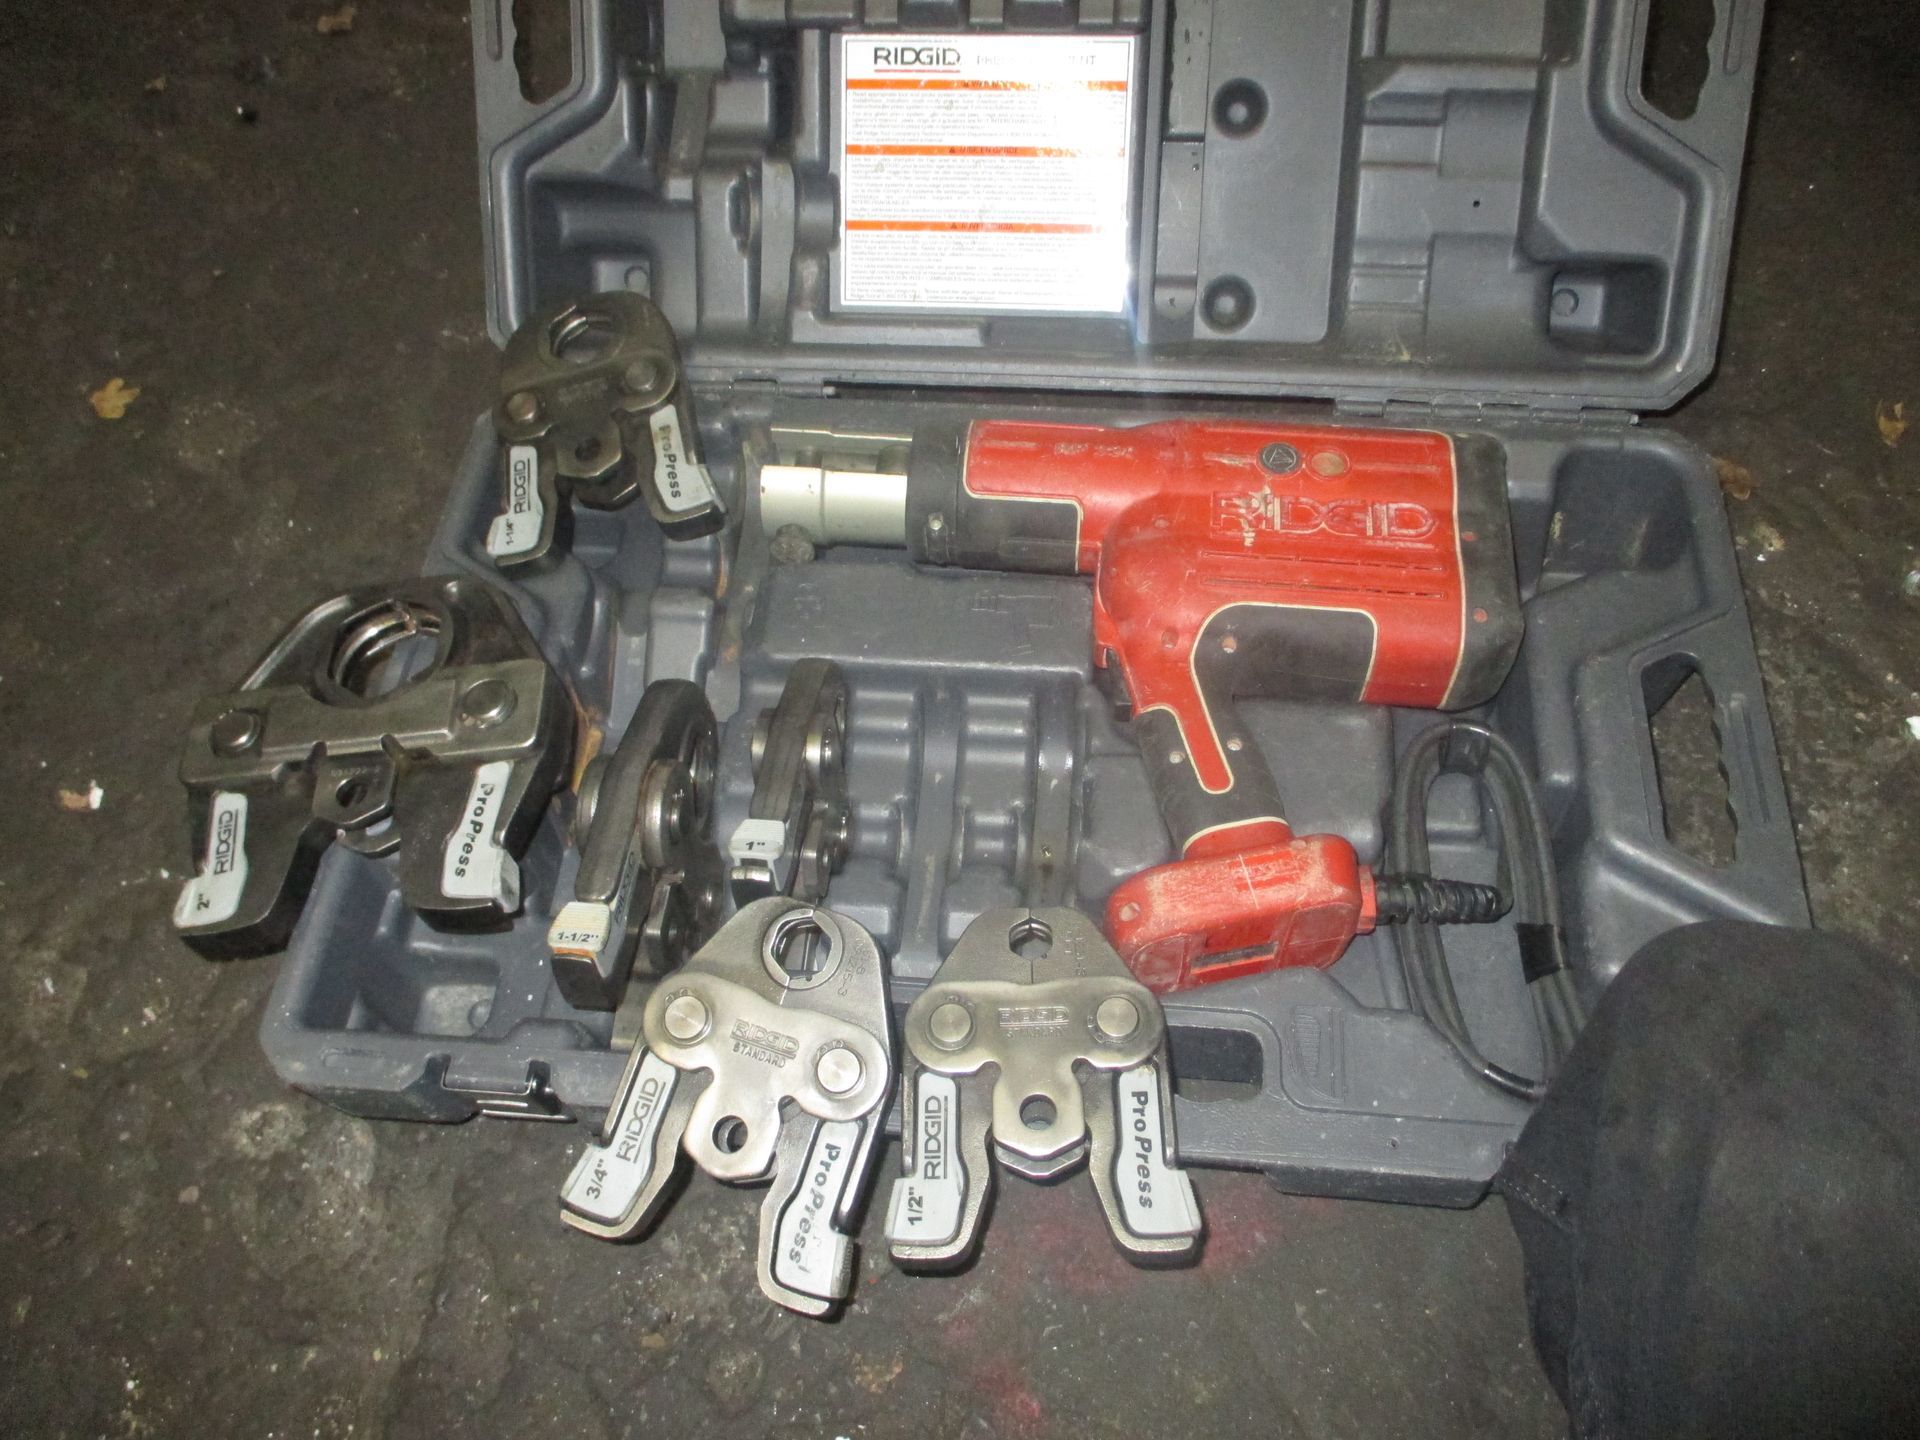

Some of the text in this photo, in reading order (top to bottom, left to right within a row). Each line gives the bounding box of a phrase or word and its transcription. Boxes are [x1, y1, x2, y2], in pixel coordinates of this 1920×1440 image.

[873, 47, 961, 65] RIDGID
[514, 459, 527, 514] RIDGID
[1212, 488, 1436, 540] RIDGID
[213, 809, 234, 876] RIDGID
[455, 783, 495, 878] ProPress
[745, 841, 766, 851] 1"
[197, 893, 210, 911] 2"
[556, 931, 599, 944] 1-1/2"
[731, 1018, 800, 1054] RIDGID
[732, 1043, 787, 1069] STANDARD
[616, 1076, 661, 1162] RIDGID
[924, 1095, 943, 1180] RIDGID
[1131, 1091, 1153, 1209] ProPress
[586, 1158, 606, 1200] 3/4"
[788, 1142, 843, 1266] ProPress
[907, 1186, 924, 1227] 1/2"
